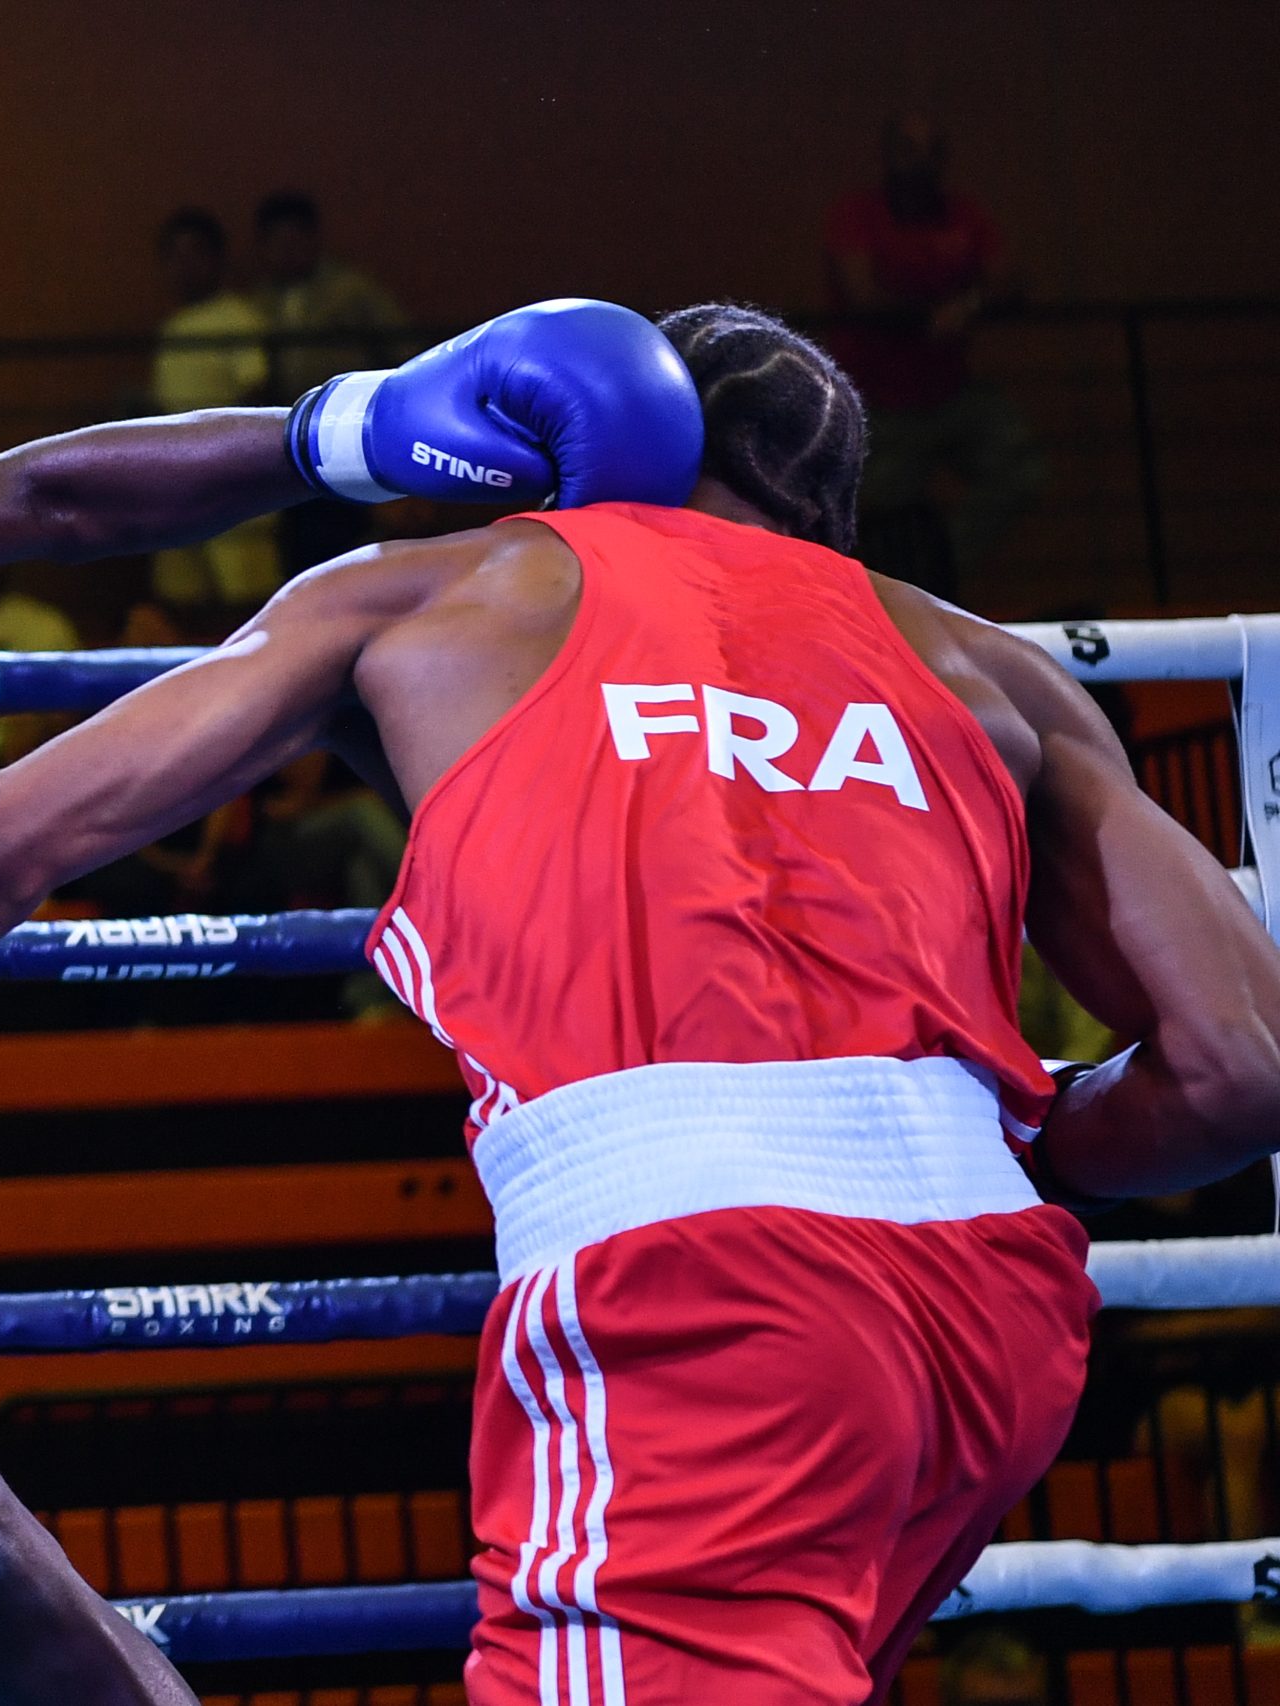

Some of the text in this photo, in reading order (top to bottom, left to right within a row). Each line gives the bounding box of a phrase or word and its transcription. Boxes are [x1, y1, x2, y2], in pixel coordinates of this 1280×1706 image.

[411, 441, 513, 488] STING
[600, 682, 931, 812] FRA
[104, 1282, 284, 1319] SHARK
[110, 1315, 286, 1337] BOXING
